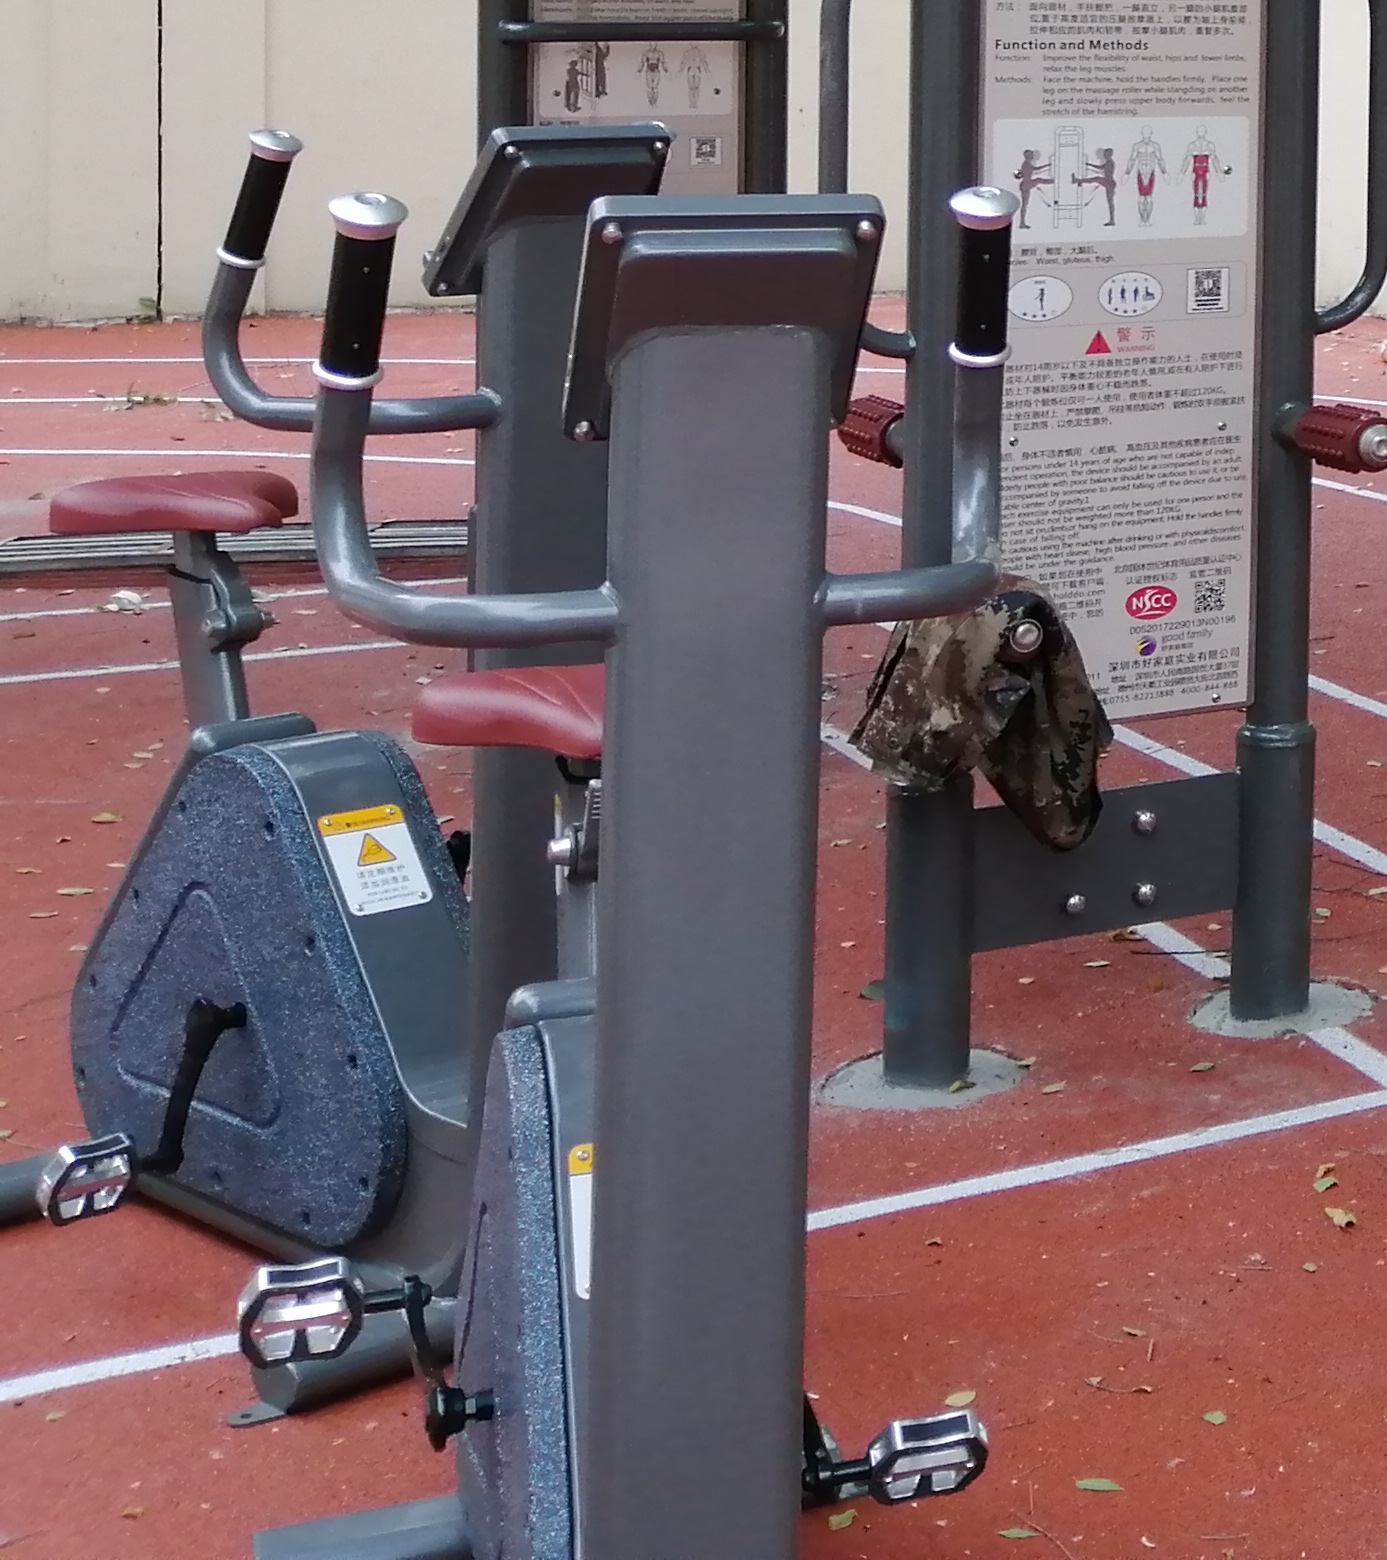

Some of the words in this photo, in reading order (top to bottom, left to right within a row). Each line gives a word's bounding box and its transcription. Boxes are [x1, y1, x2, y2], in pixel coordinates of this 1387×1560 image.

[995, 38, 1055, 50] Function
[1059, 39, 1084, 50] and
[1089, 39, 1148, 50] Methods
